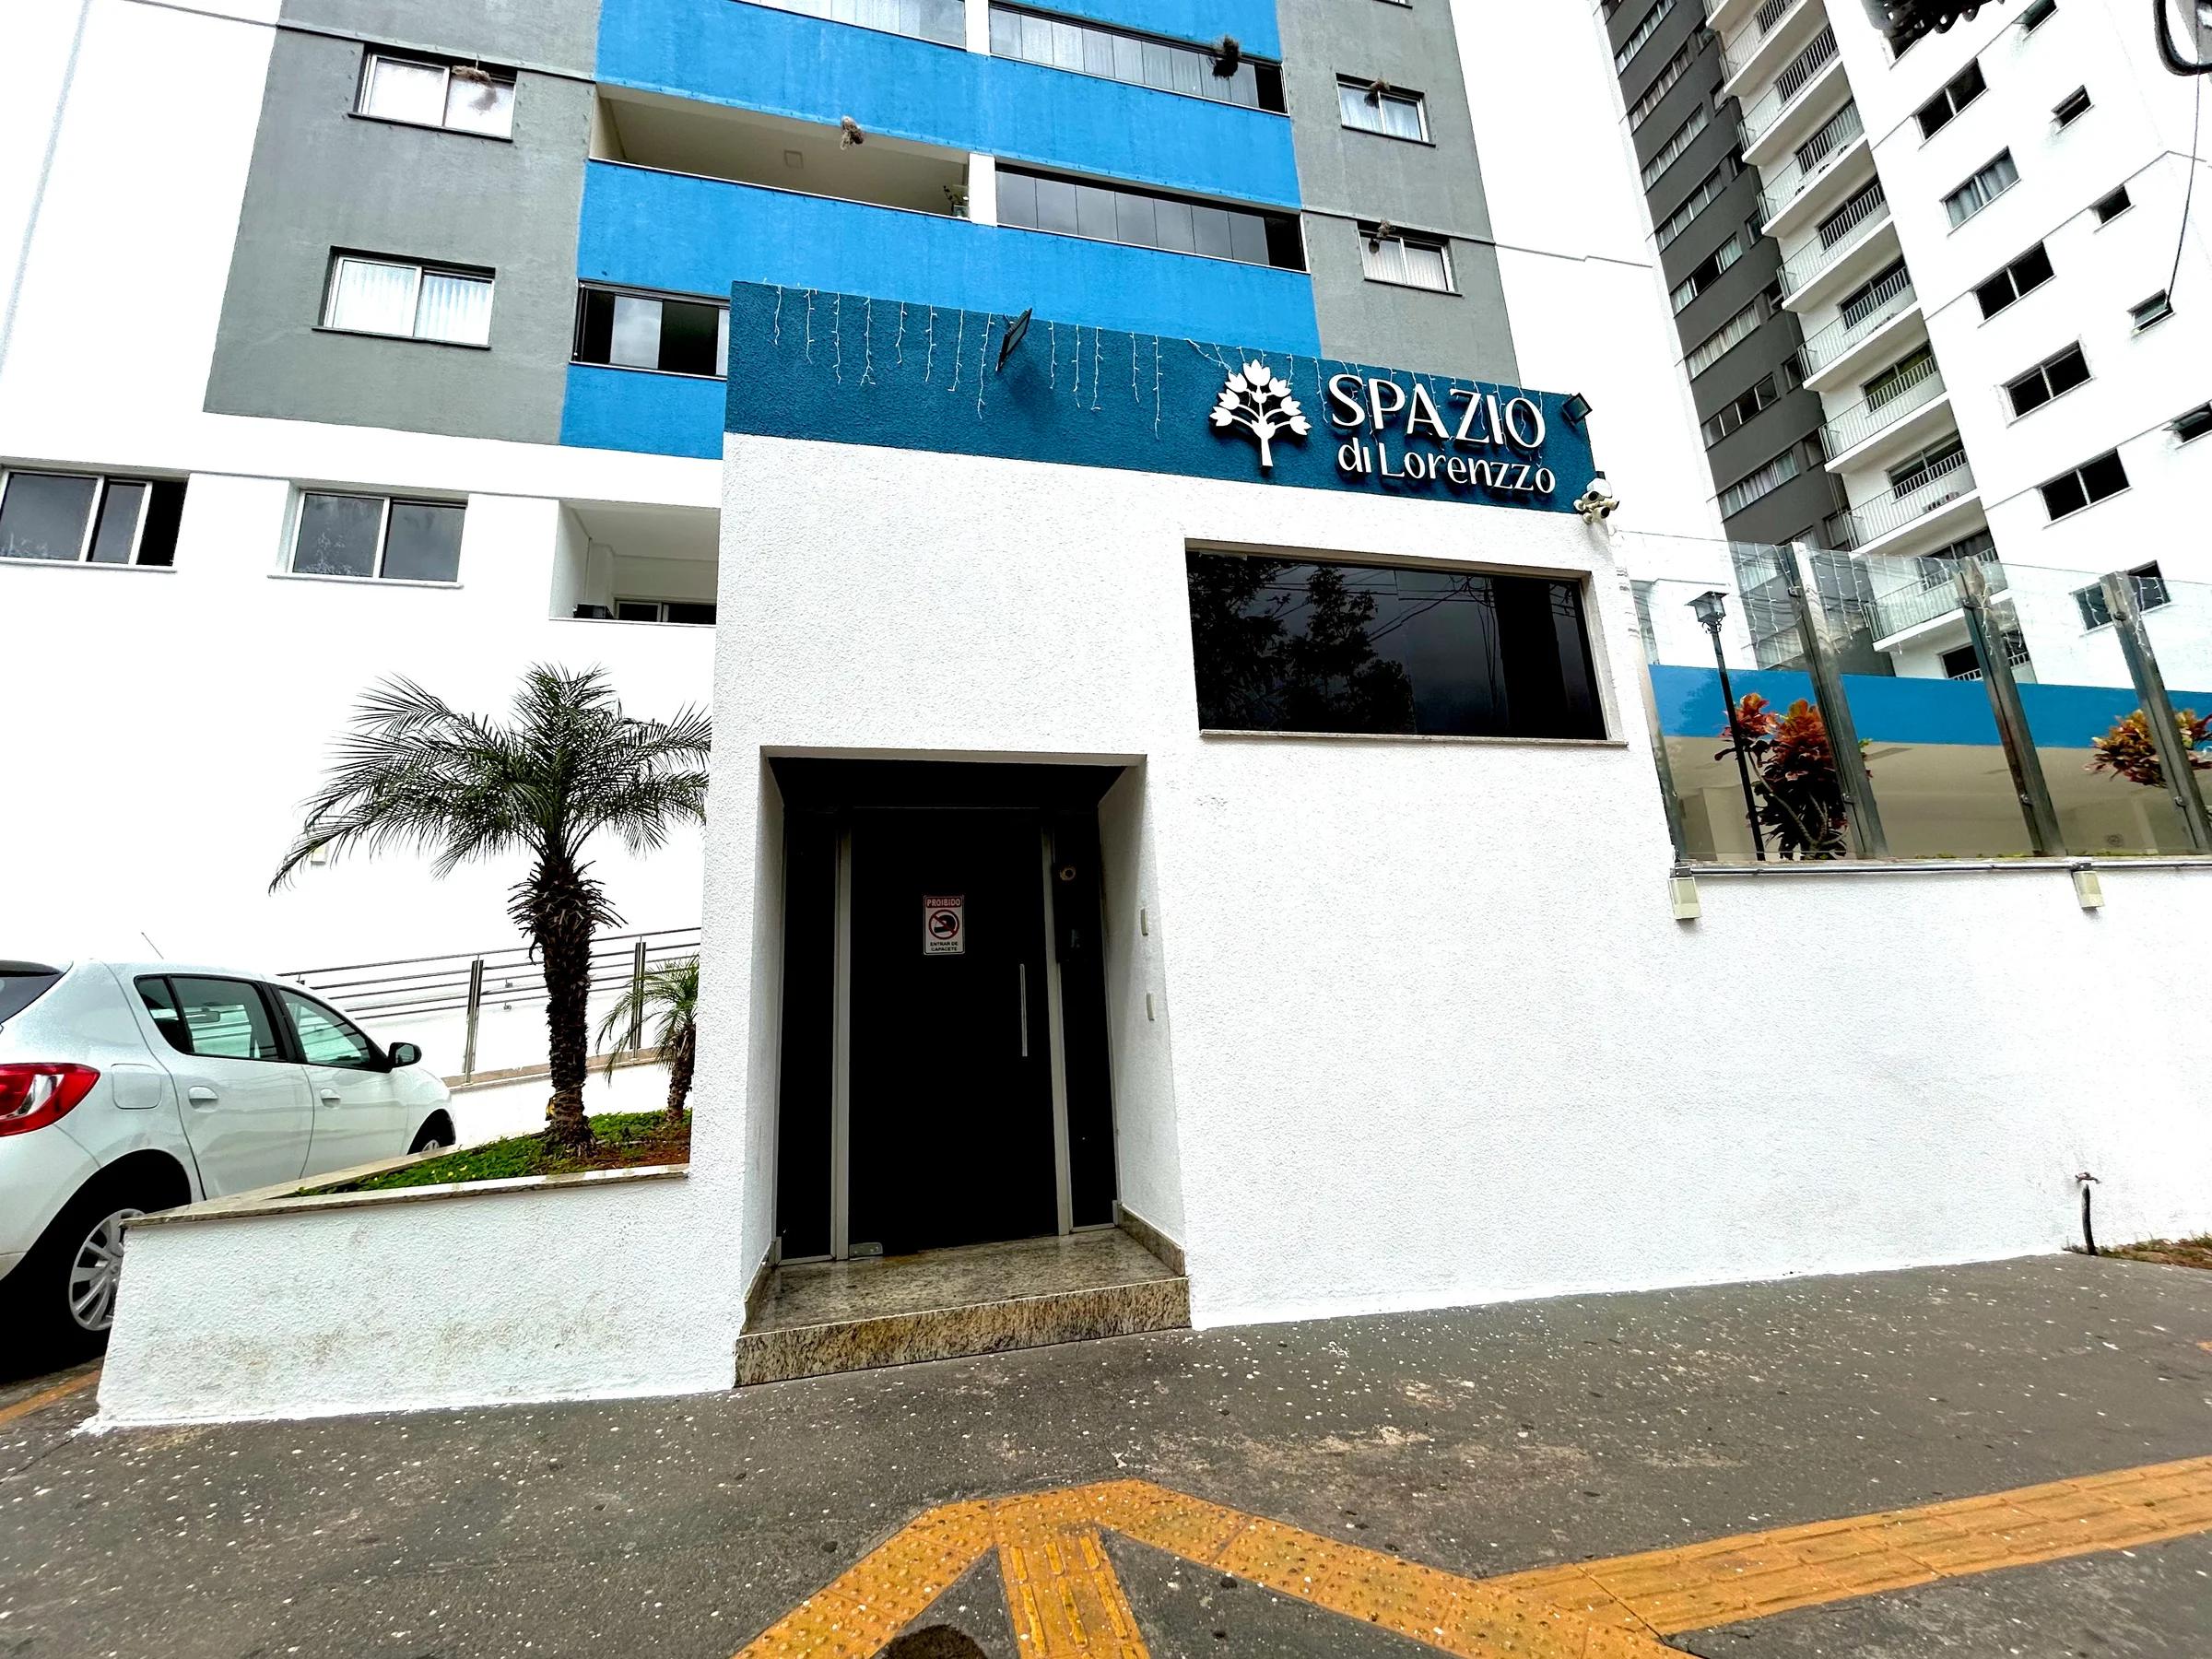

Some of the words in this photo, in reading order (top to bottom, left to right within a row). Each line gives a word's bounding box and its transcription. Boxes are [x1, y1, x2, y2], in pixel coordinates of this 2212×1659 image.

[1328, 373, 1547, 449] SPAZIO
[1337, 437, 1371, 473] di
[1378, 441, 1556, 494] Lorenzzo
[926, 899, 960, 907] PROIBIDO
